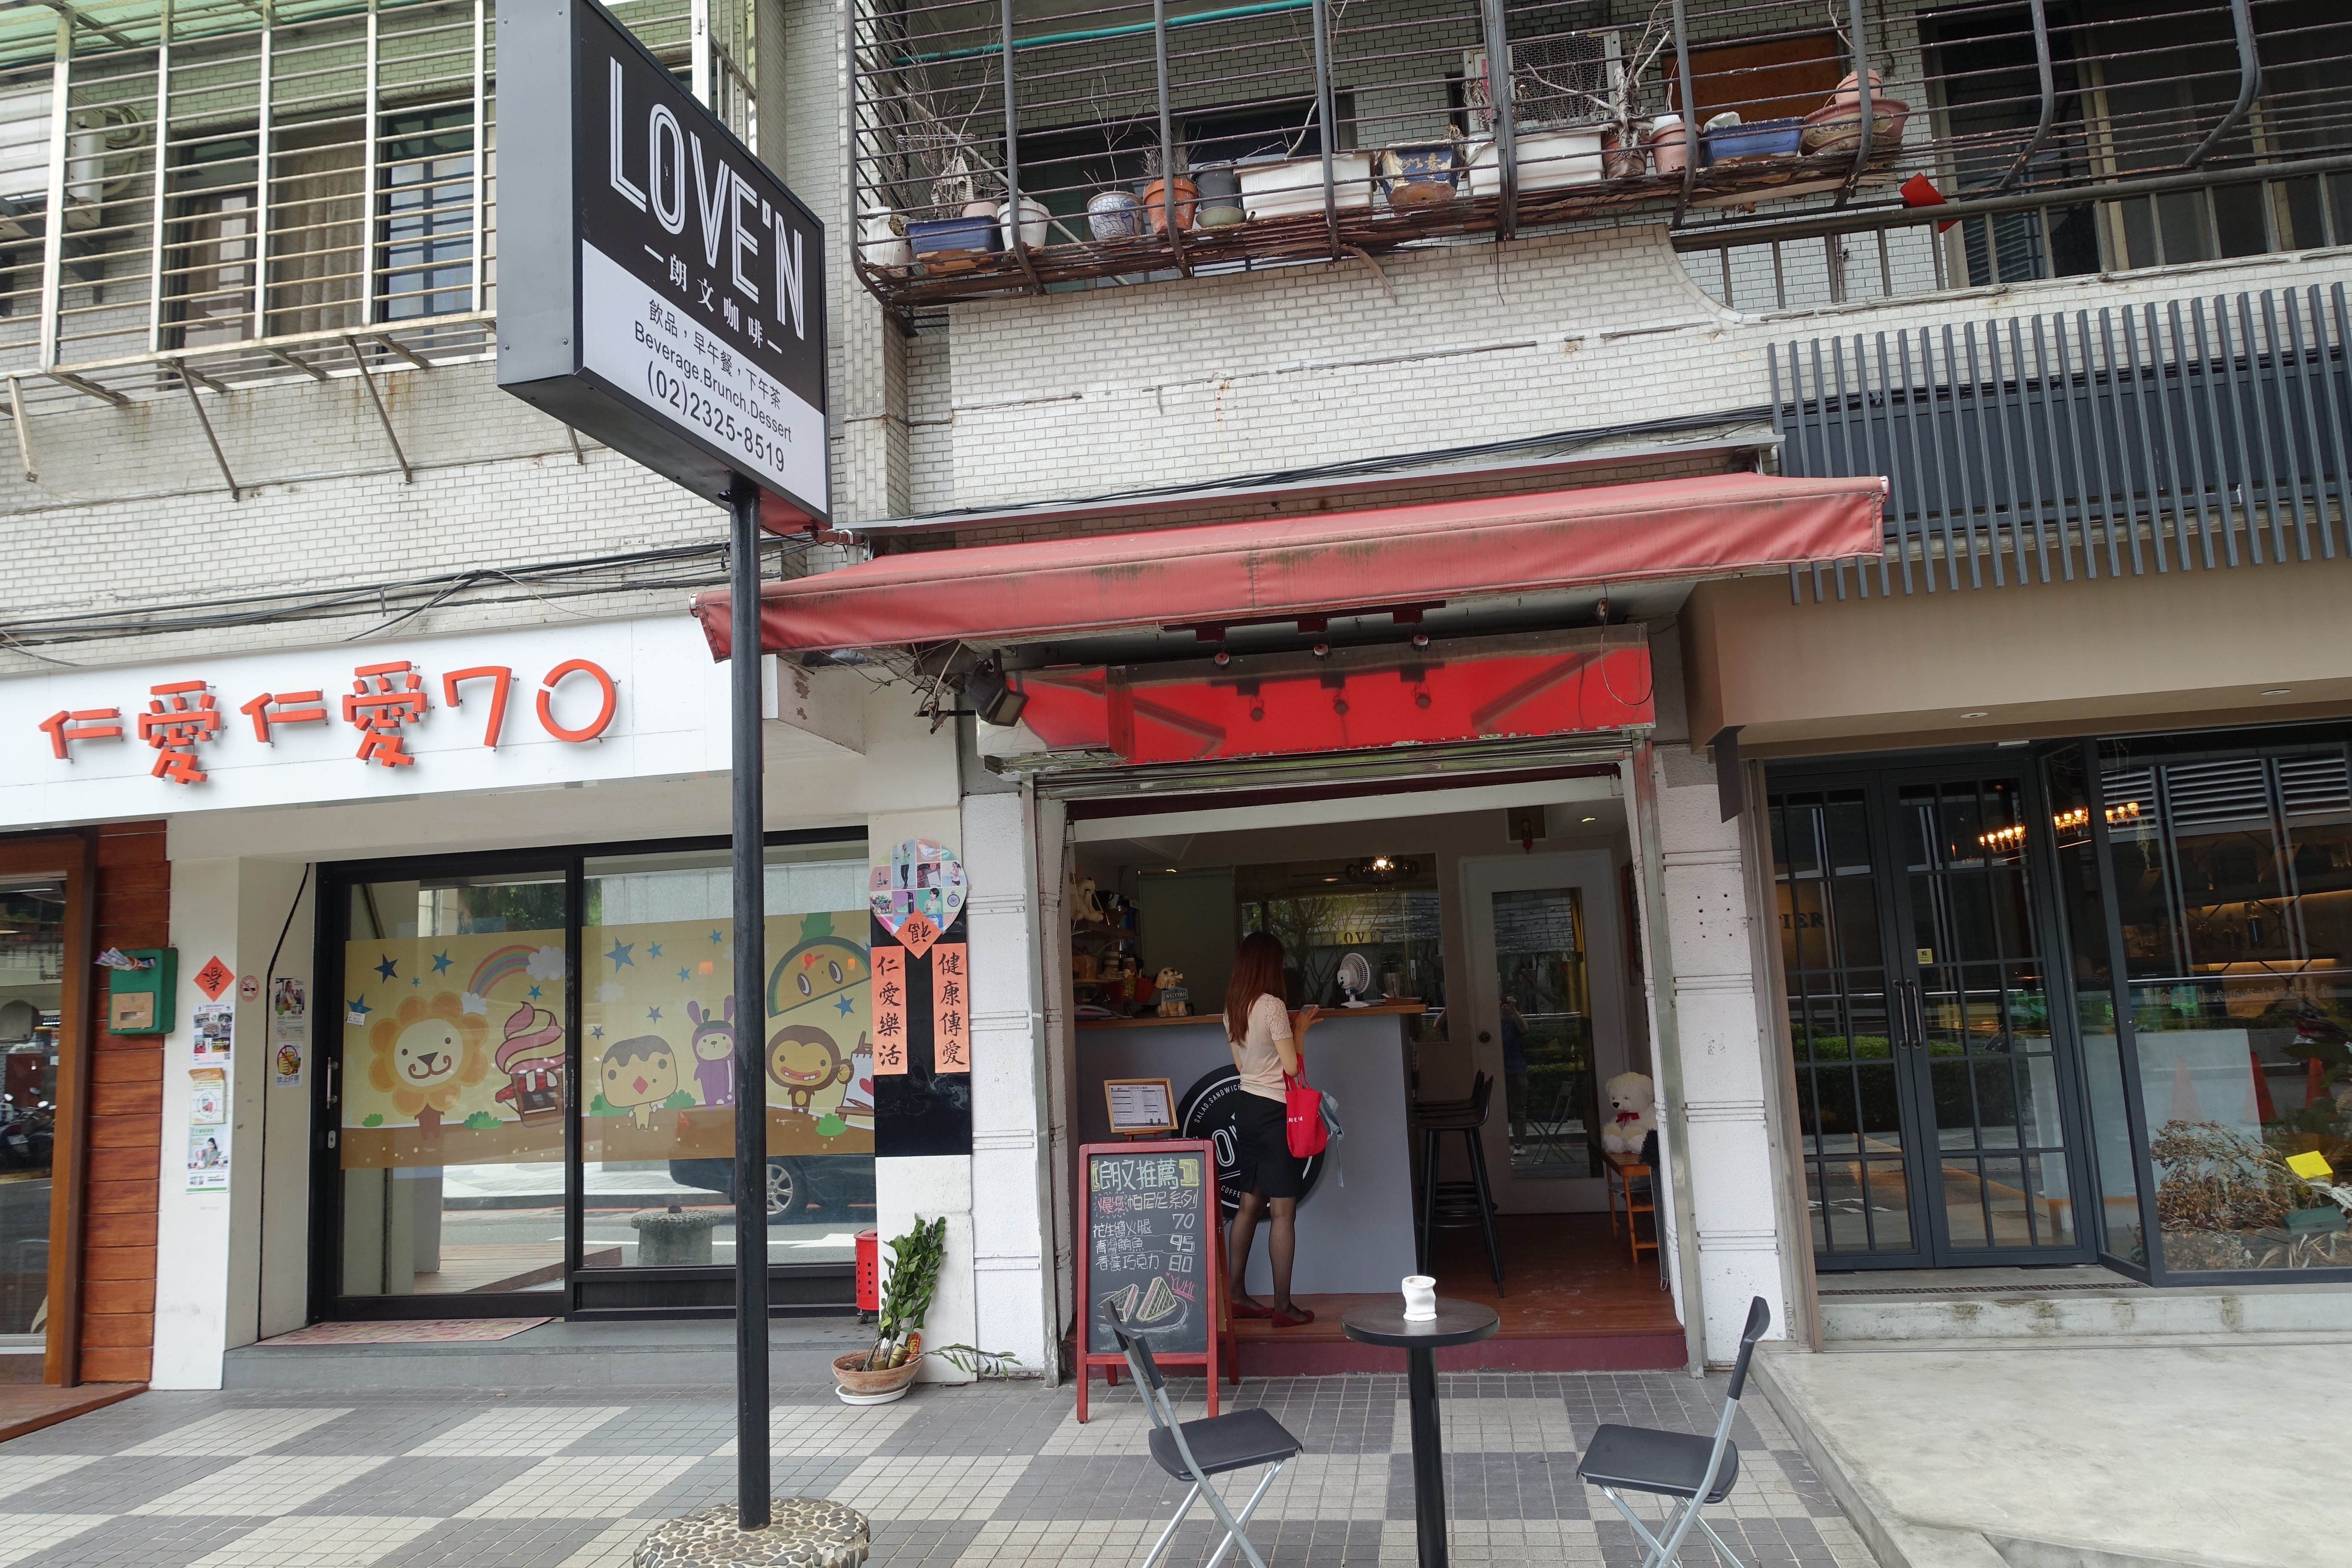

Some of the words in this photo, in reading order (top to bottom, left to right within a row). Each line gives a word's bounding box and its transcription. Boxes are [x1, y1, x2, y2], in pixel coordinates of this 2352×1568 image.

[610, 56, 805, 340] LOVE'N
[635, 321, 792, 443] Beverage.Brunch.Dessert
[648, 361, 785, 472] (02)2325-8519
[908, 921, 931, 943] 福
[202, 967, 223, 991] 春
[877, 956, 901, 1066] 仁愛樂活
[937, 952, 966, 1066] 健康傳愛
[1170, 1235, 1195, 1253] 95
[1172, 1213, 1194, 1230] 70
[1169, 1255, 1192, 1273] 80
